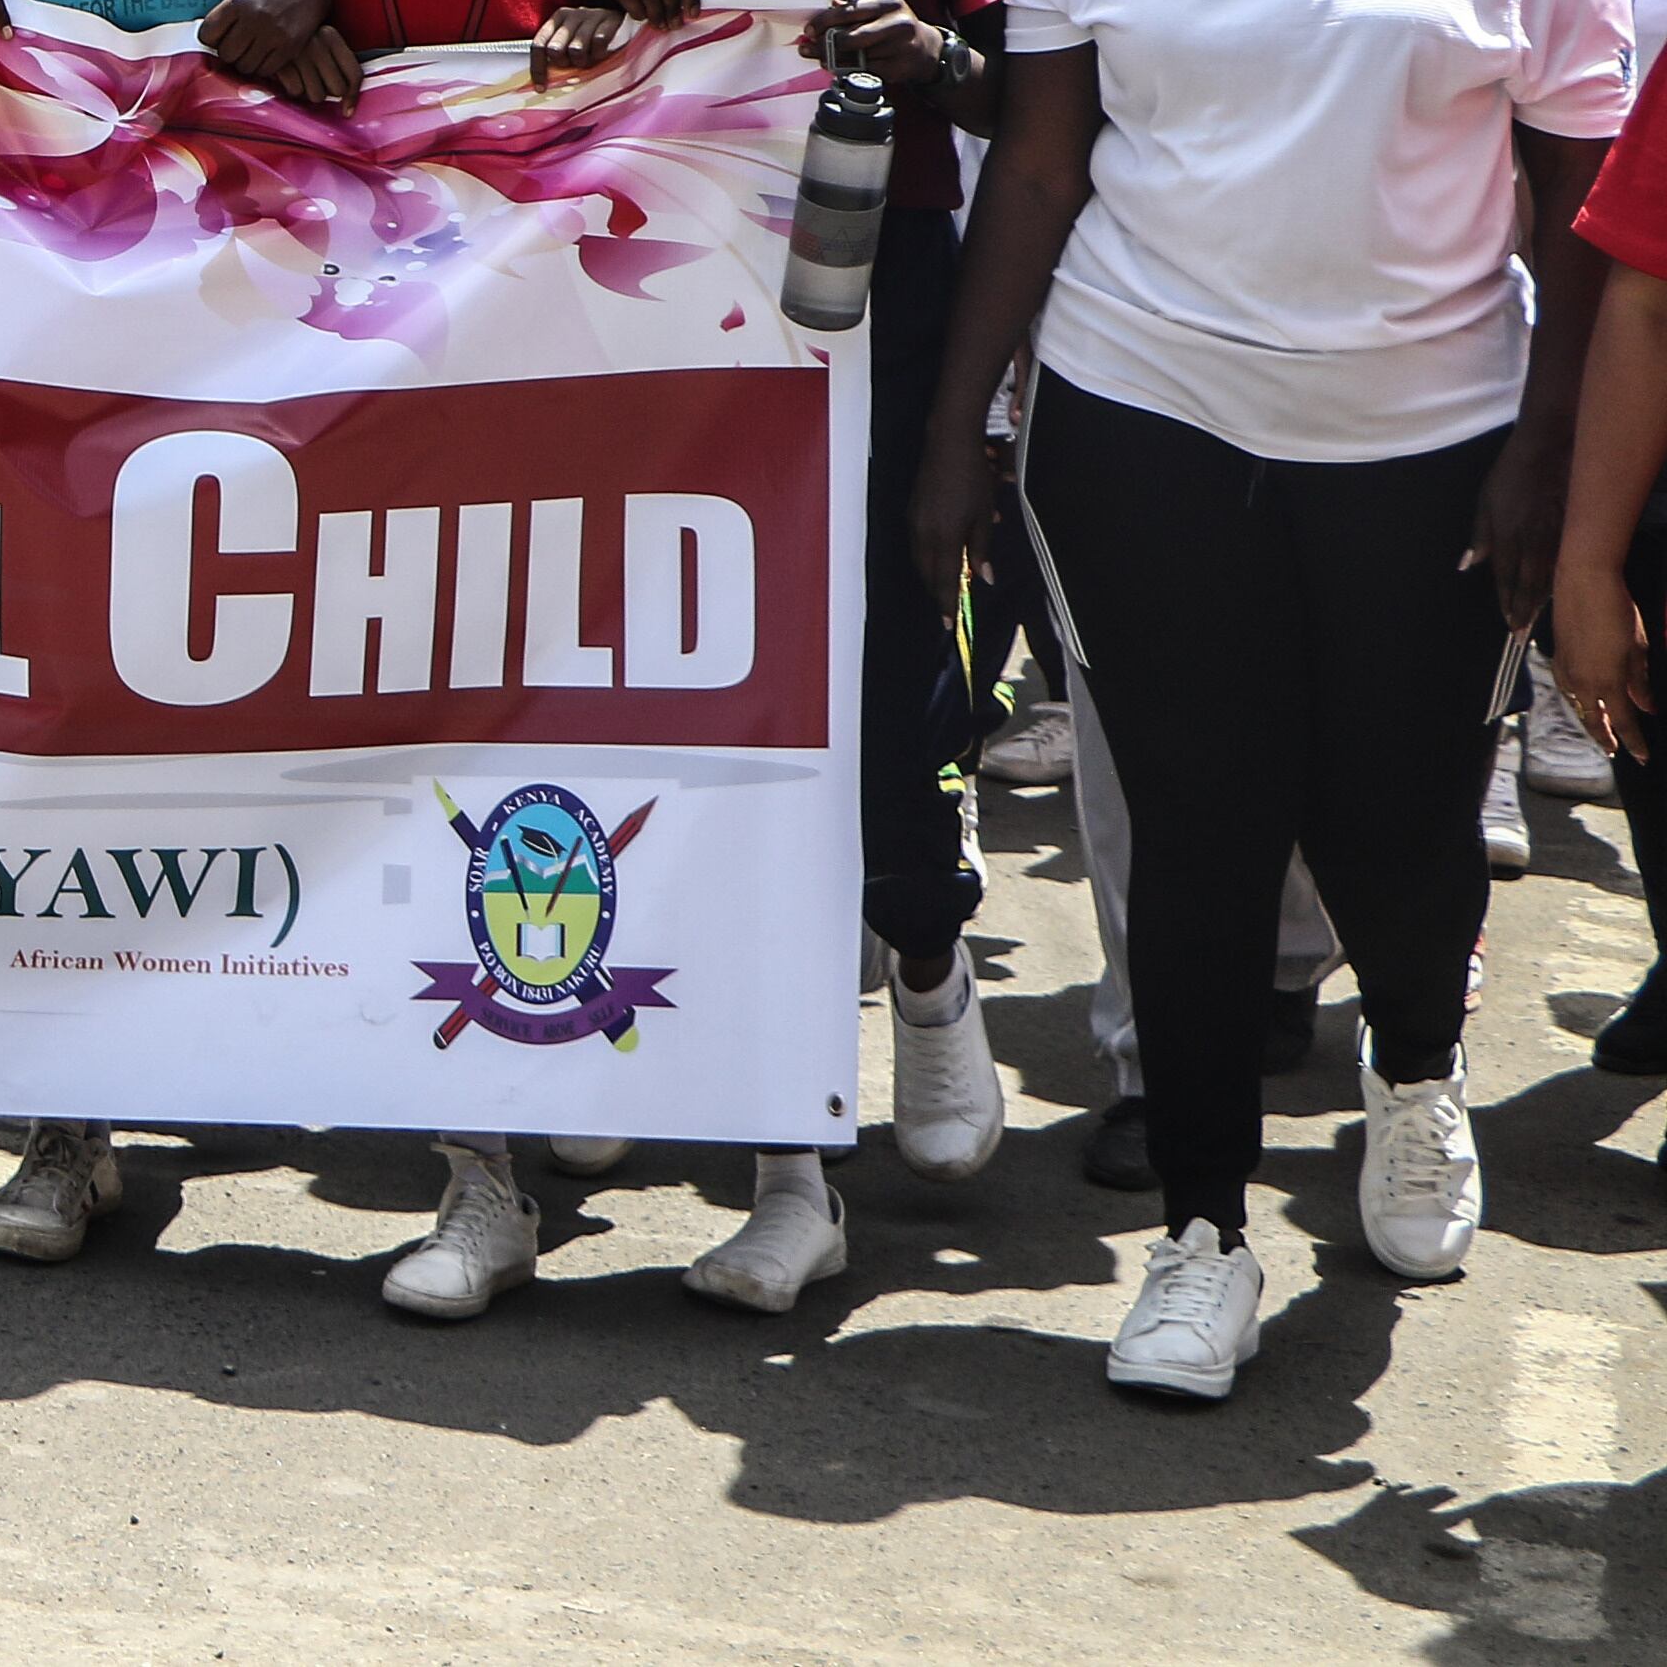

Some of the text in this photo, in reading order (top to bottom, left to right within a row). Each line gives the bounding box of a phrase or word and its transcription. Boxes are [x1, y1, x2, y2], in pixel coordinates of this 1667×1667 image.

[108, 428, 758, 708] CHILD
[468, 789, 615, 897] SOAR KENYA ACADEMY
[10, 948, 104, 972] African
[113, 950, 212, 975] Women
[221, 953, 351, 979] Initiatives
[554, 944, 602, 997] NAKURU
